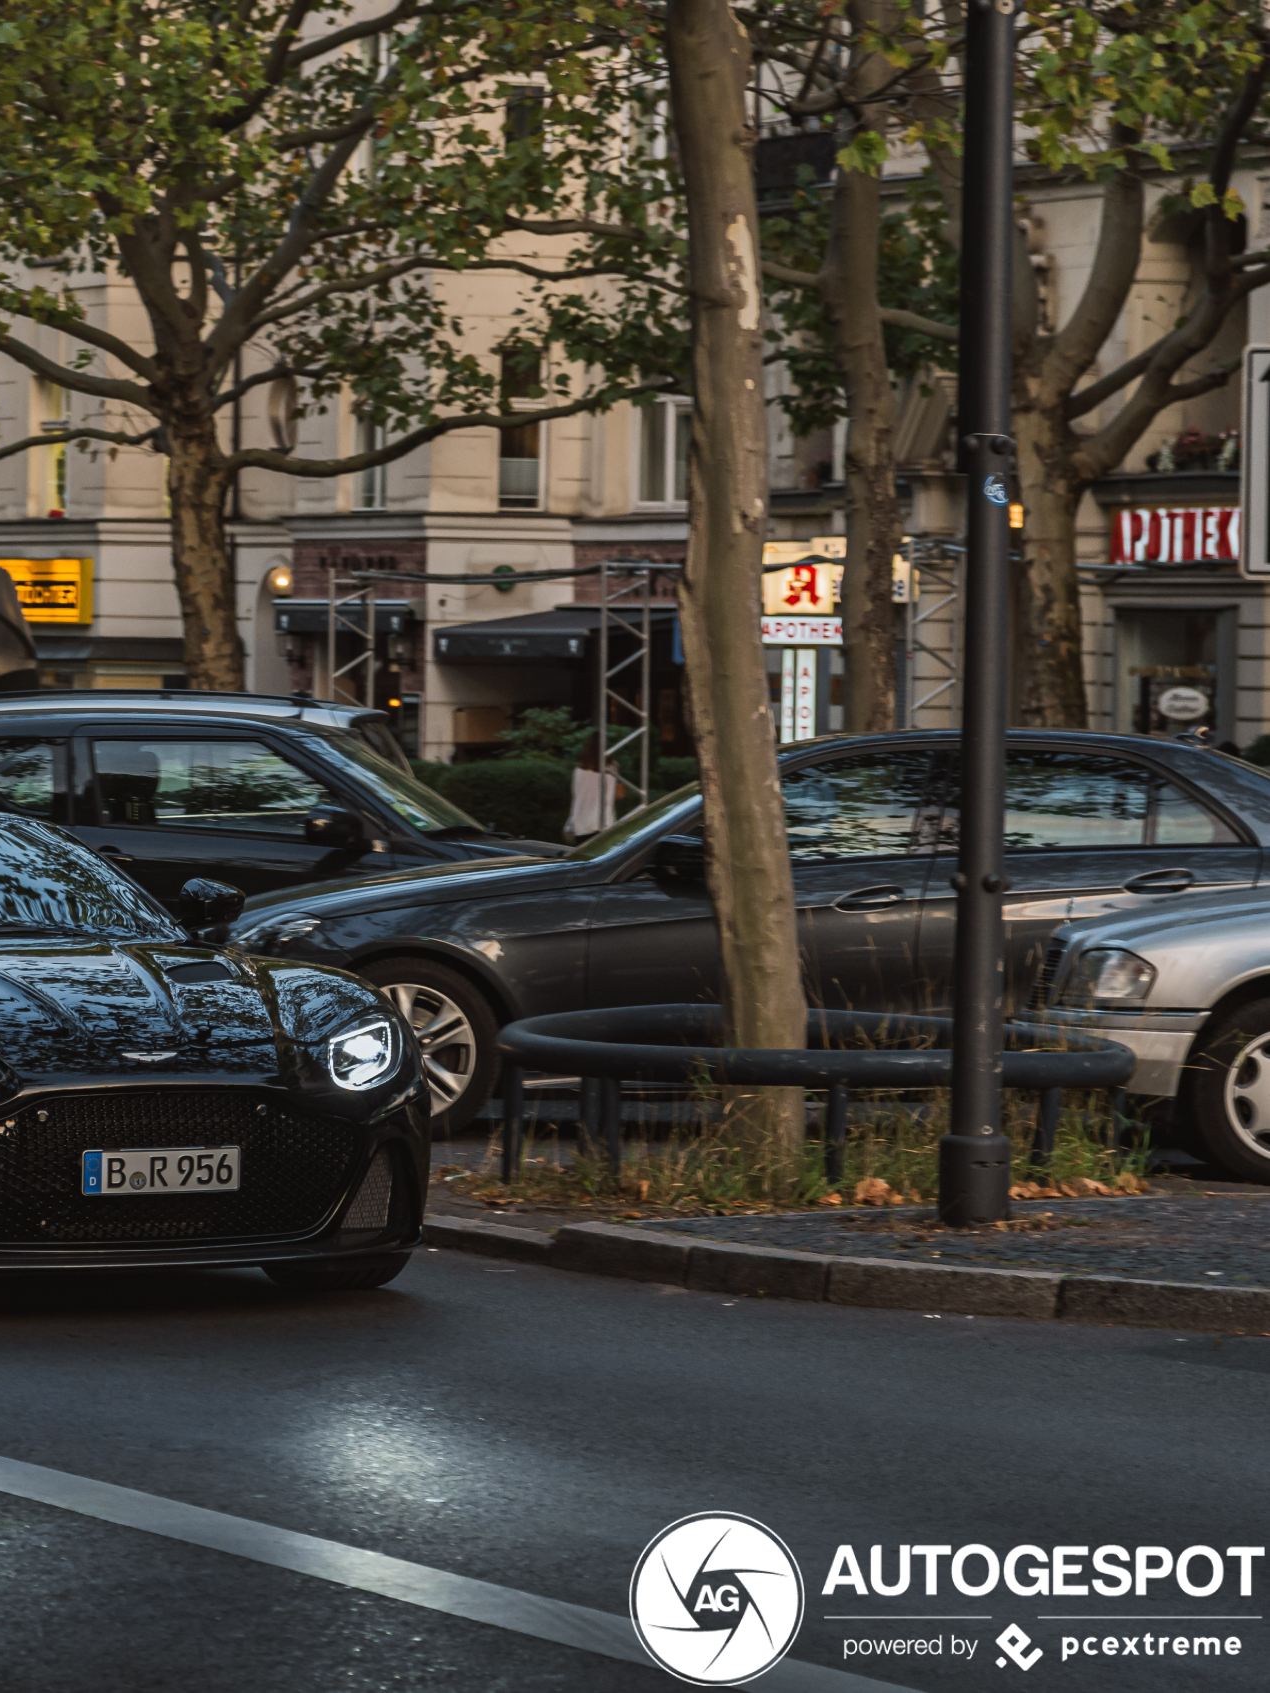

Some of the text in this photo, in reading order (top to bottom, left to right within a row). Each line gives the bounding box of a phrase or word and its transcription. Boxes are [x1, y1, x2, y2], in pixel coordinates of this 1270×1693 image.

[107, 1153, 233, 1188] B R 956
